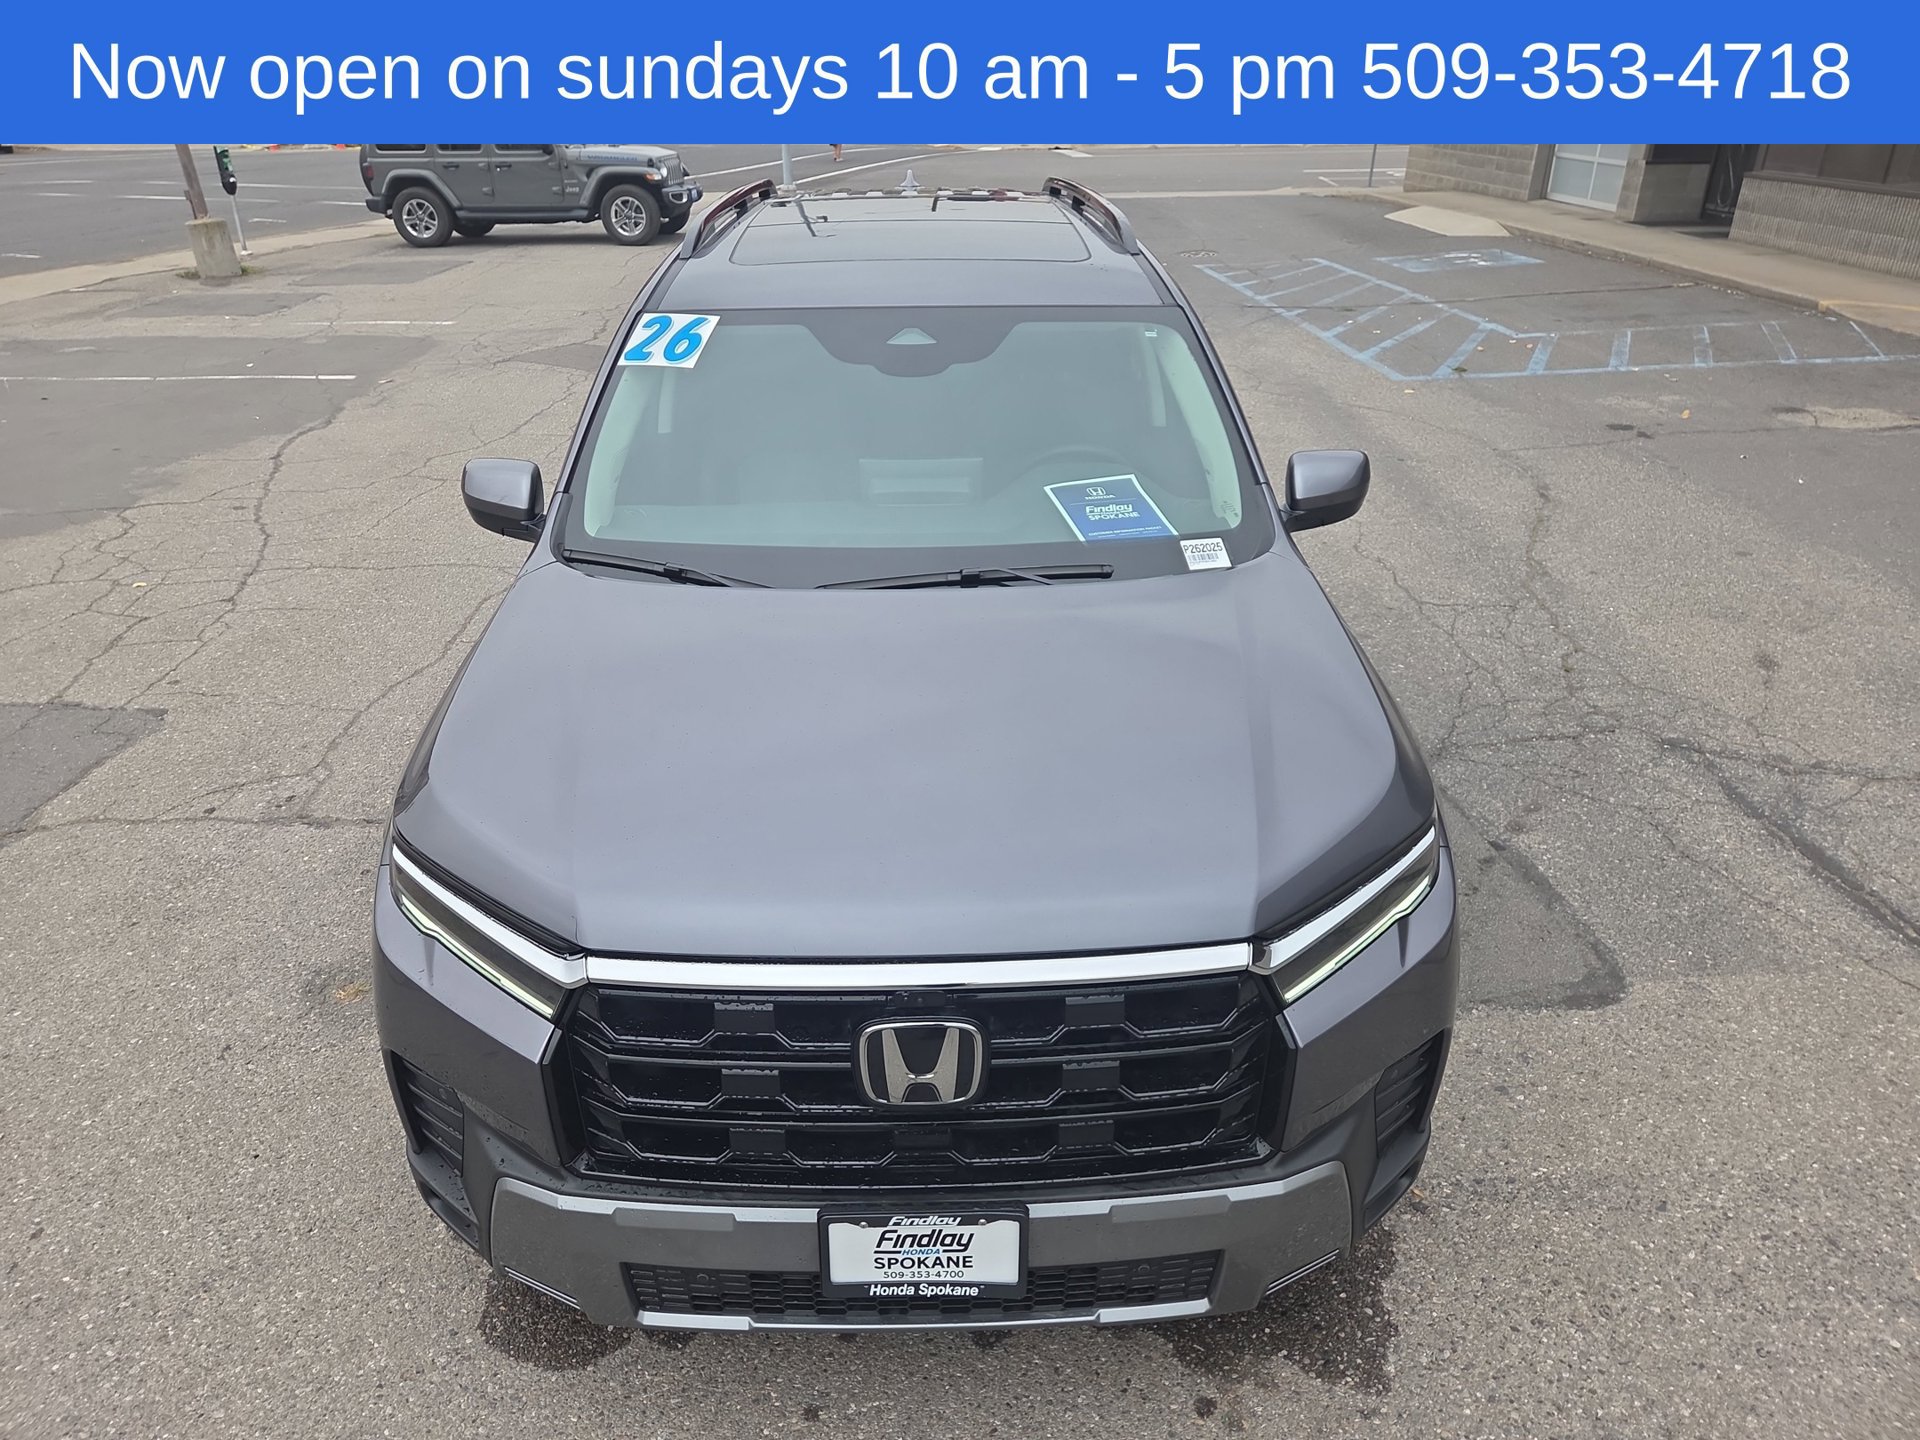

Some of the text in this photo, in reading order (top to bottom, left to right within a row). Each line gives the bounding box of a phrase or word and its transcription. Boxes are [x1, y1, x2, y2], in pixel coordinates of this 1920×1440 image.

[623, 314, 711, 363] 26
[1085, 503, 1134, 515] Findlay
[1088, 511, 1141, 521] SPOKANE
[1183, 541, 1223, 554] P262025
[888, 1215, 962, 1226] Findlay
[875, 1228, 975, 1253] Findlay
[902, 1248, 941, 1256] HONDA
[873, 1255, 974, 1270] SPOKANE
[883, 1270, 965, 1279] 509-353-4700
[869, 1283, 979, 1298] Honda Spokane
